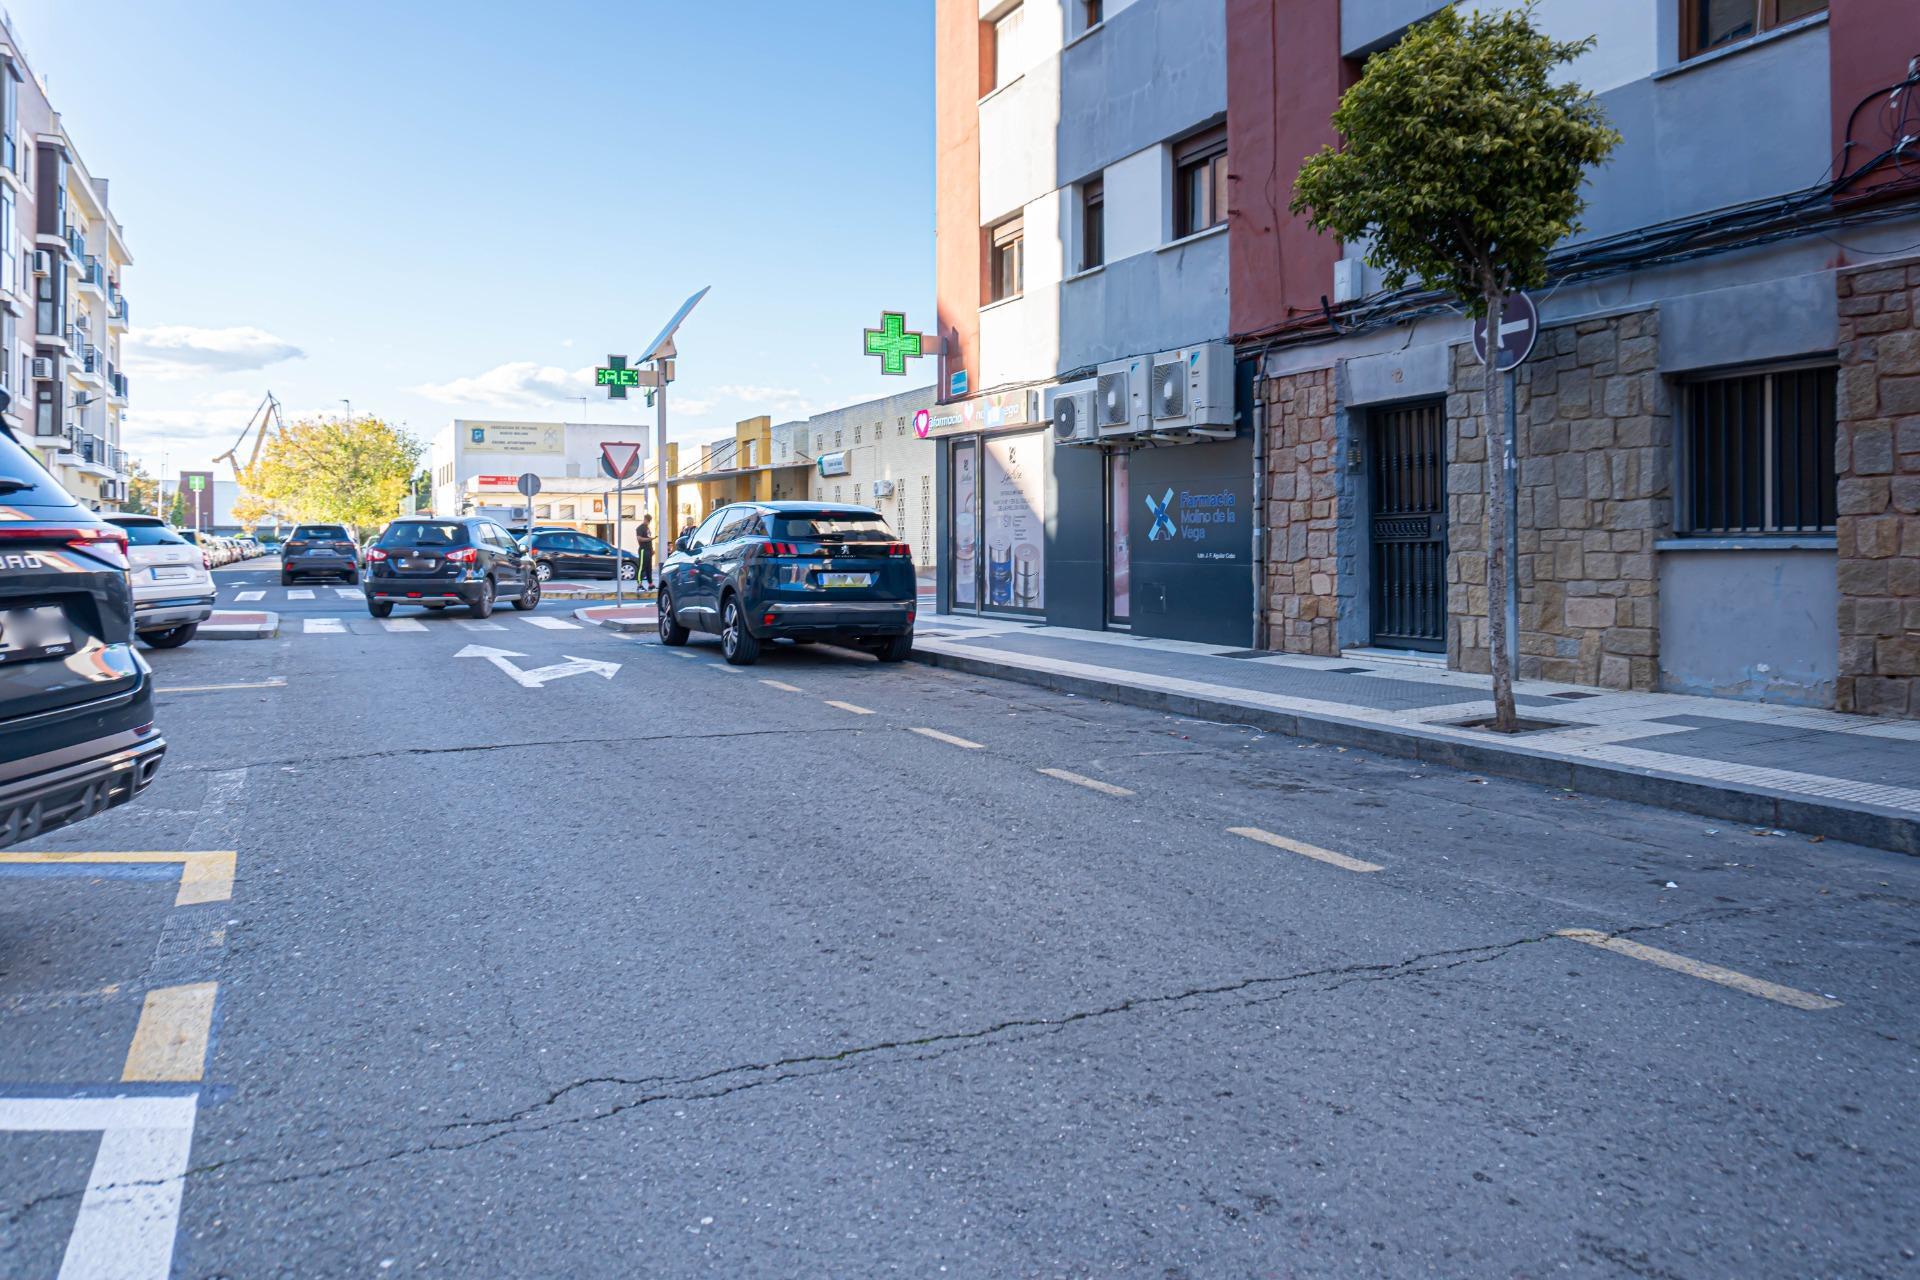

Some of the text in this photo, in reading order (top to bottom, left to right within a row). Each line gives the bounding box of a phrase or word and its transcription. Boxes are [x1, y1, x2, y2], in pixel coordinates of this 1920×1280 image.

[1392, 368, 1405, 384] 12
[1180, 489, 1236, 508] Farmacia
[1180, 507, 1236, 524] Molino de la
[1180, 525, 1207, 543] Vega
